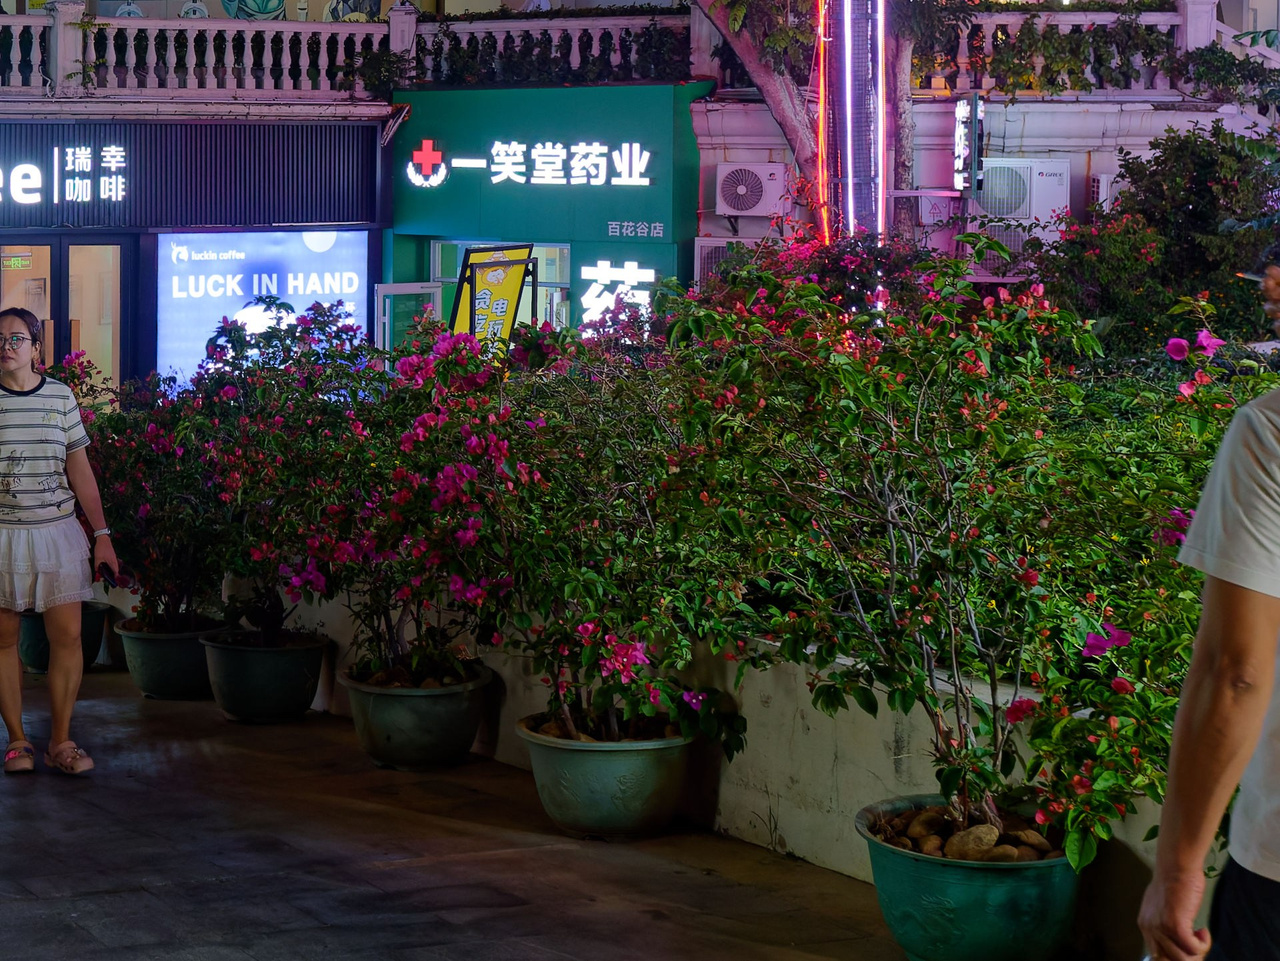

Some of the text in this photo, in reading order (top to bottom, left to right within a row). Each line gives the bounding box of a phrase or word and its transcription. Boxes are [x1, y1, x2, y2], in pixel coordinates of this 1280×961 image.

[65, 145, 126, 172] 瑞幸
[451, 141, 650, 186] 一笑堂药业
[65, 175, 126, 202] 咖啡
[607, 222, 664, 237] 百花谷店
[192, 250, 246, 261] luckin coffee
[172, 272, 360, 298] LUCK IN HAND
